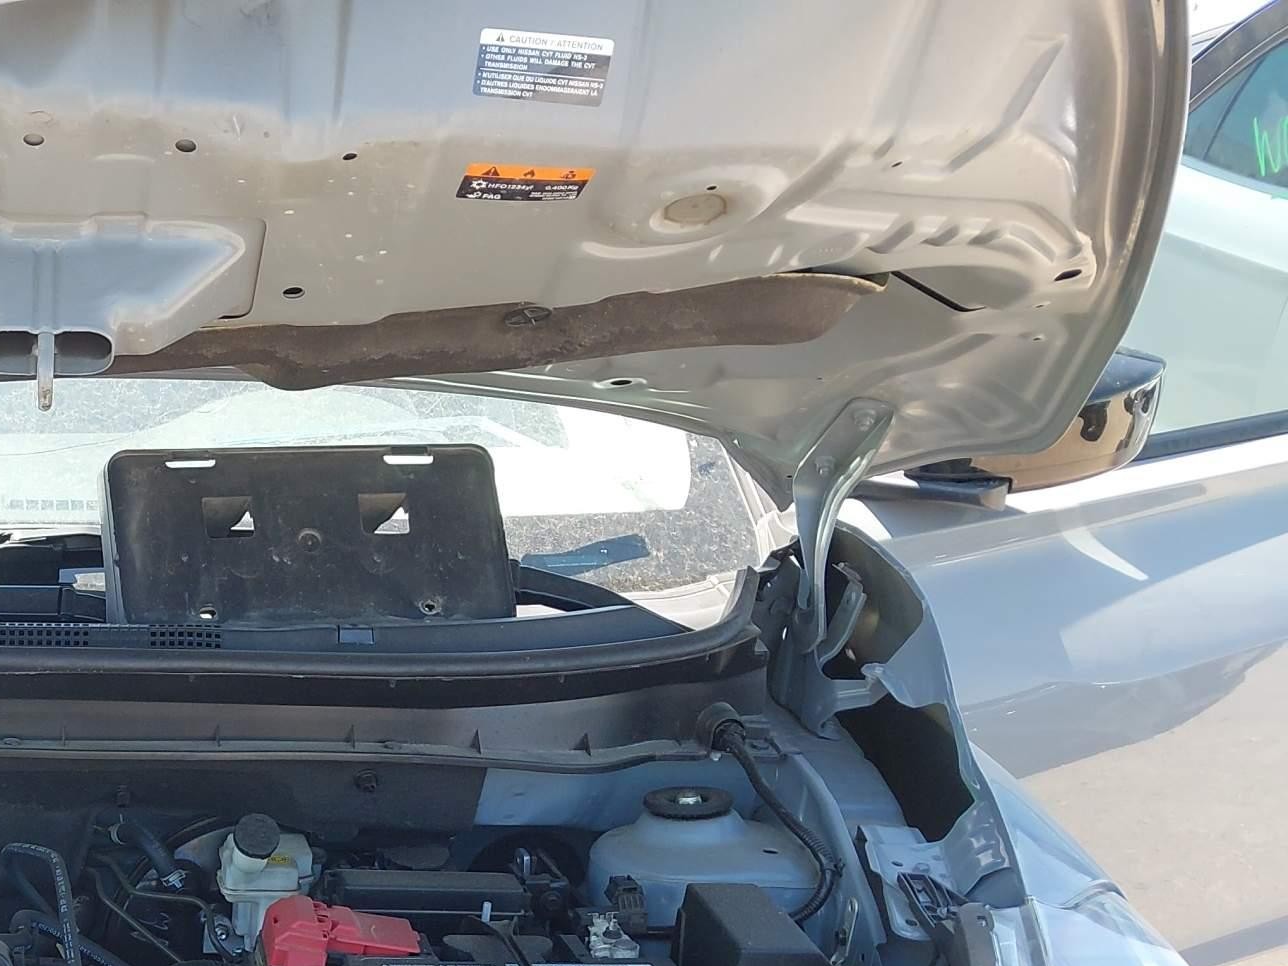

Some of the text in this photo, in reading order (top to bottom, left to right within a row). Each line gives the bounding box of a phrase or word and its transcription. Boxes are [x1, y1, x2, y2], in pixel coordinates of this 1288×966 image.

[508, 35, 547, 45] CAUTION
[556, 39, 603, 50] ATTENTION
[517, 48, 540, 56] NISSAN
[484, 60, 527, 70] TRANSMISSION
[480, 87, 521, 96] TRANSMISSION
